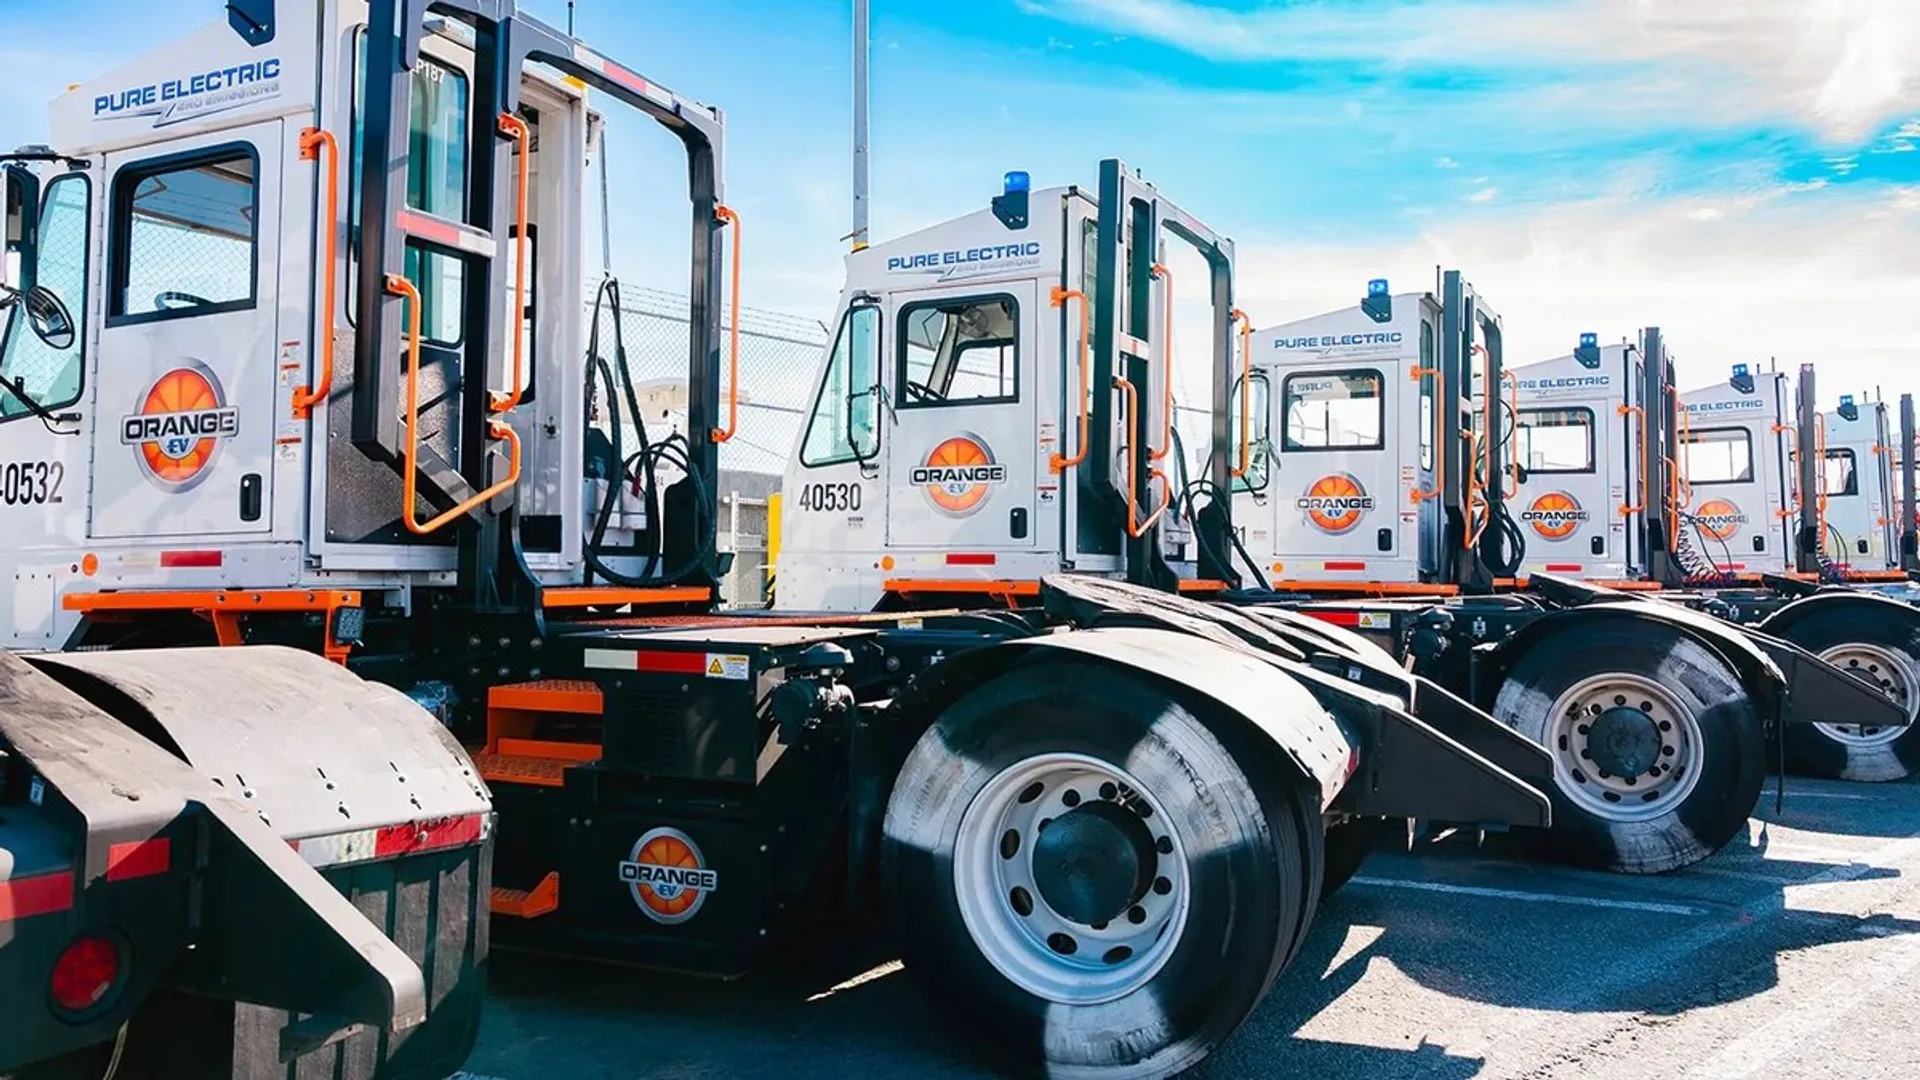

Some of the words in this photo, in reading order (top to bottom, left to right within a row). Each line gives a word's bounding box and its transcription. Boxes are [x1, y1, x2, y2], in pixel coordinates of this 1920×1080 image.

[94, 85, 156, 115] PURE
[161, 58, 280, 101] ELECTRIC
[888, 253, 939, 271] PURE
[943, 242, 1040, 264] ELECTRIC
[1275, 337, 1317, 349] PURE
[1322, 332, 1402, 346] ELECTRIC
[1539, 376, 1609, 388] ELECTRIC
[125, 411, 235, 439] ORANGE
[166, 438, 190, 454] EV
[913, 467, 1003, 483] ORANGE
[949, 483, 967, 493] EV
[799, 482, 862, 512] 40530
[1298, 497, 1373, 509] ORANGE
[1521, 510, 1588, 521] ORANGE
[622, 864, 715, 888] ORANGE
[656, 884, 678, 896] EV
